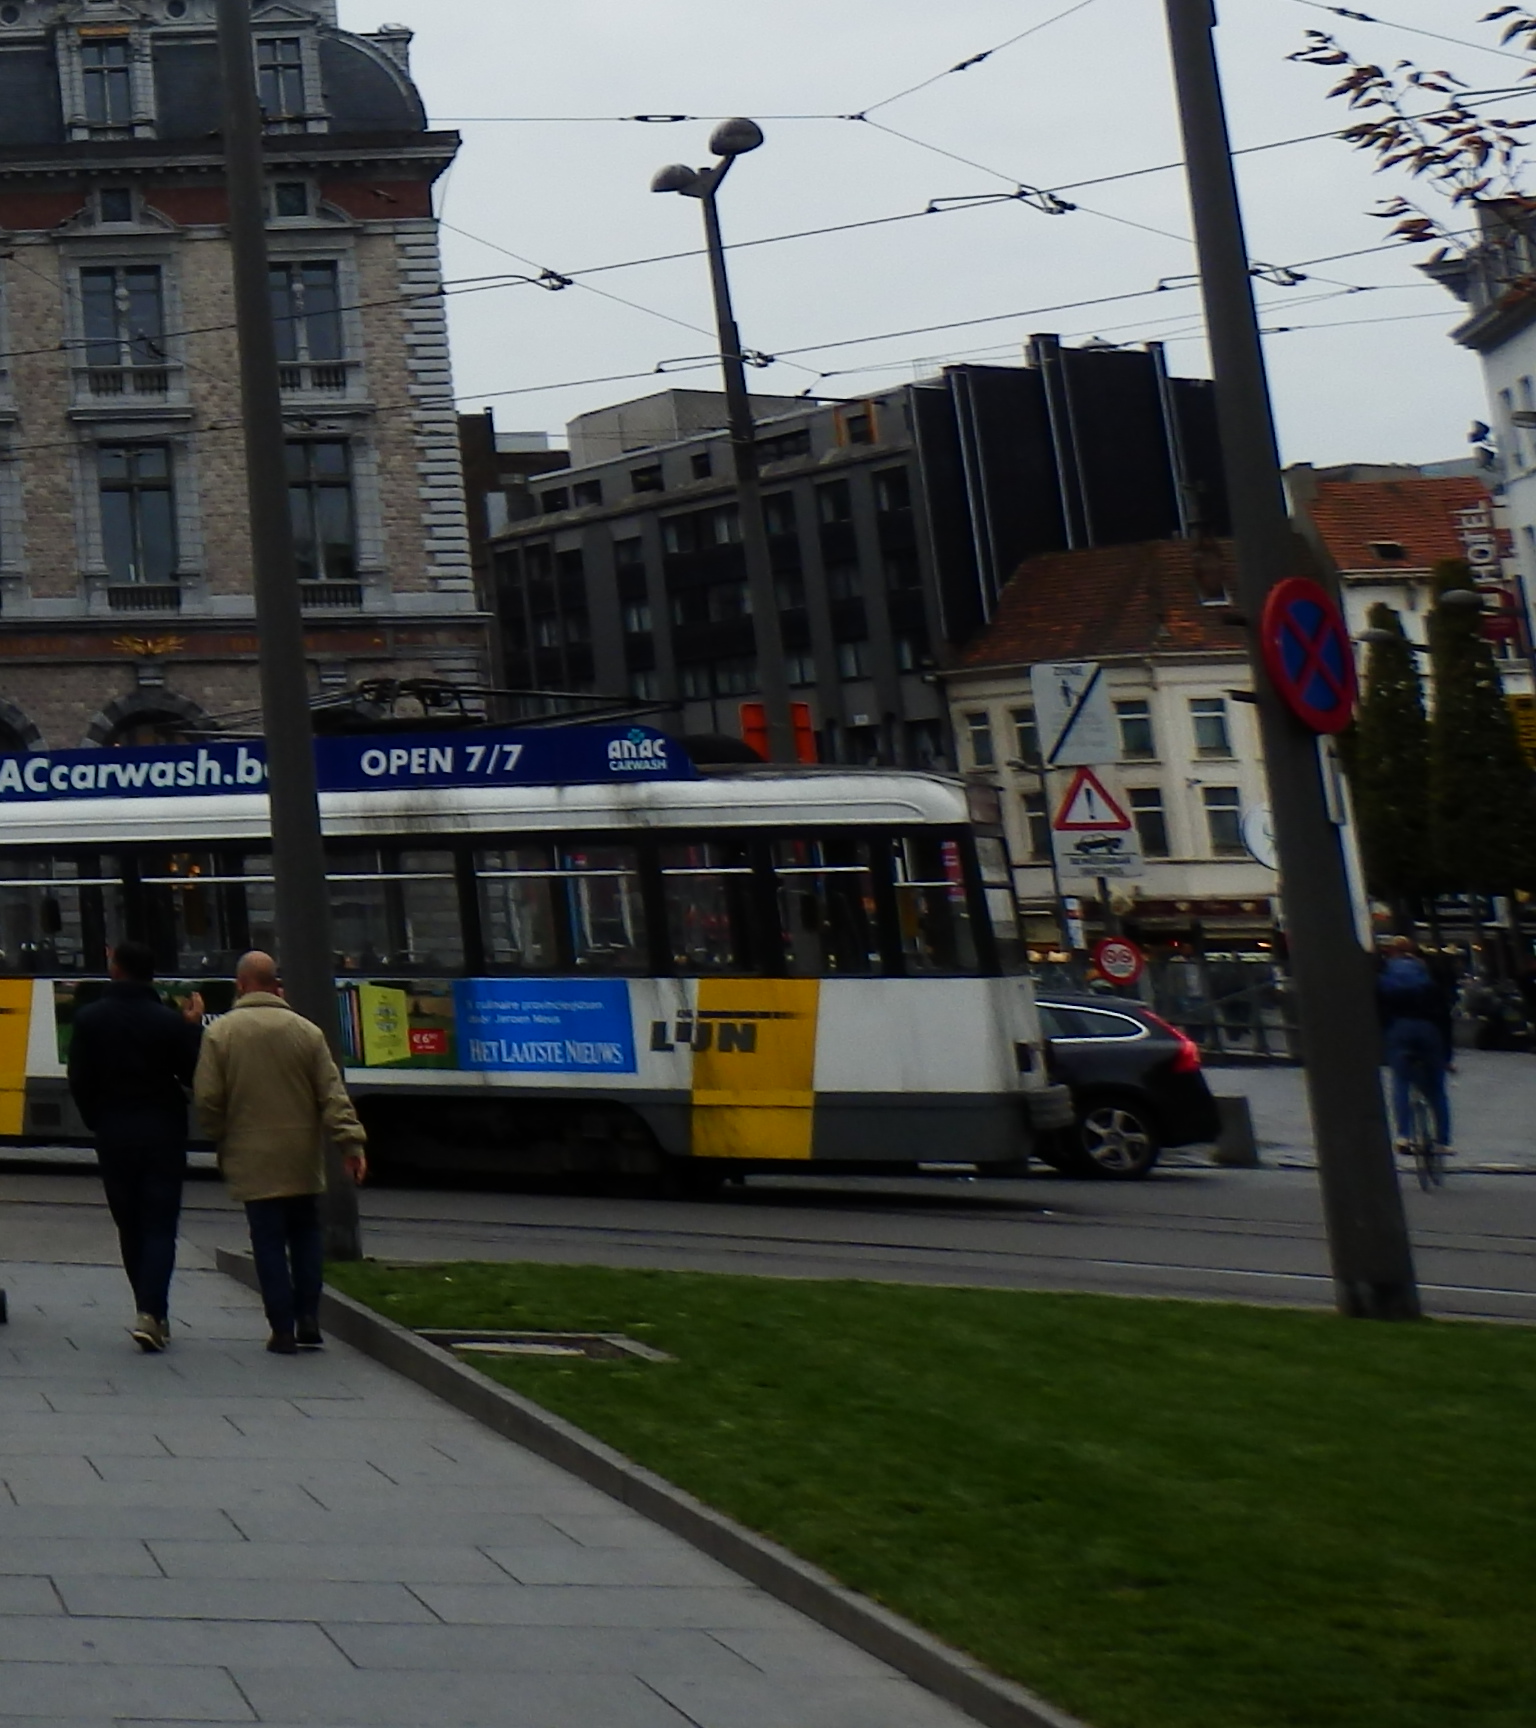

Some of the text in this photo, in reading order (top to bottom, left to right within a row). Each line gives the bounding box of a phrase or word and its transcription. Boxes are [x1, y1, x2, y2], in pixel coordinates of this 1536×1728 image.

[360, 744, 523, 776] OPEN 7/7
[609, 758, 667, 771] CARWASH
[499, 1038, 564, 1064] LAATSTE
[565, 1039, 623, 1065] NIEUWS
